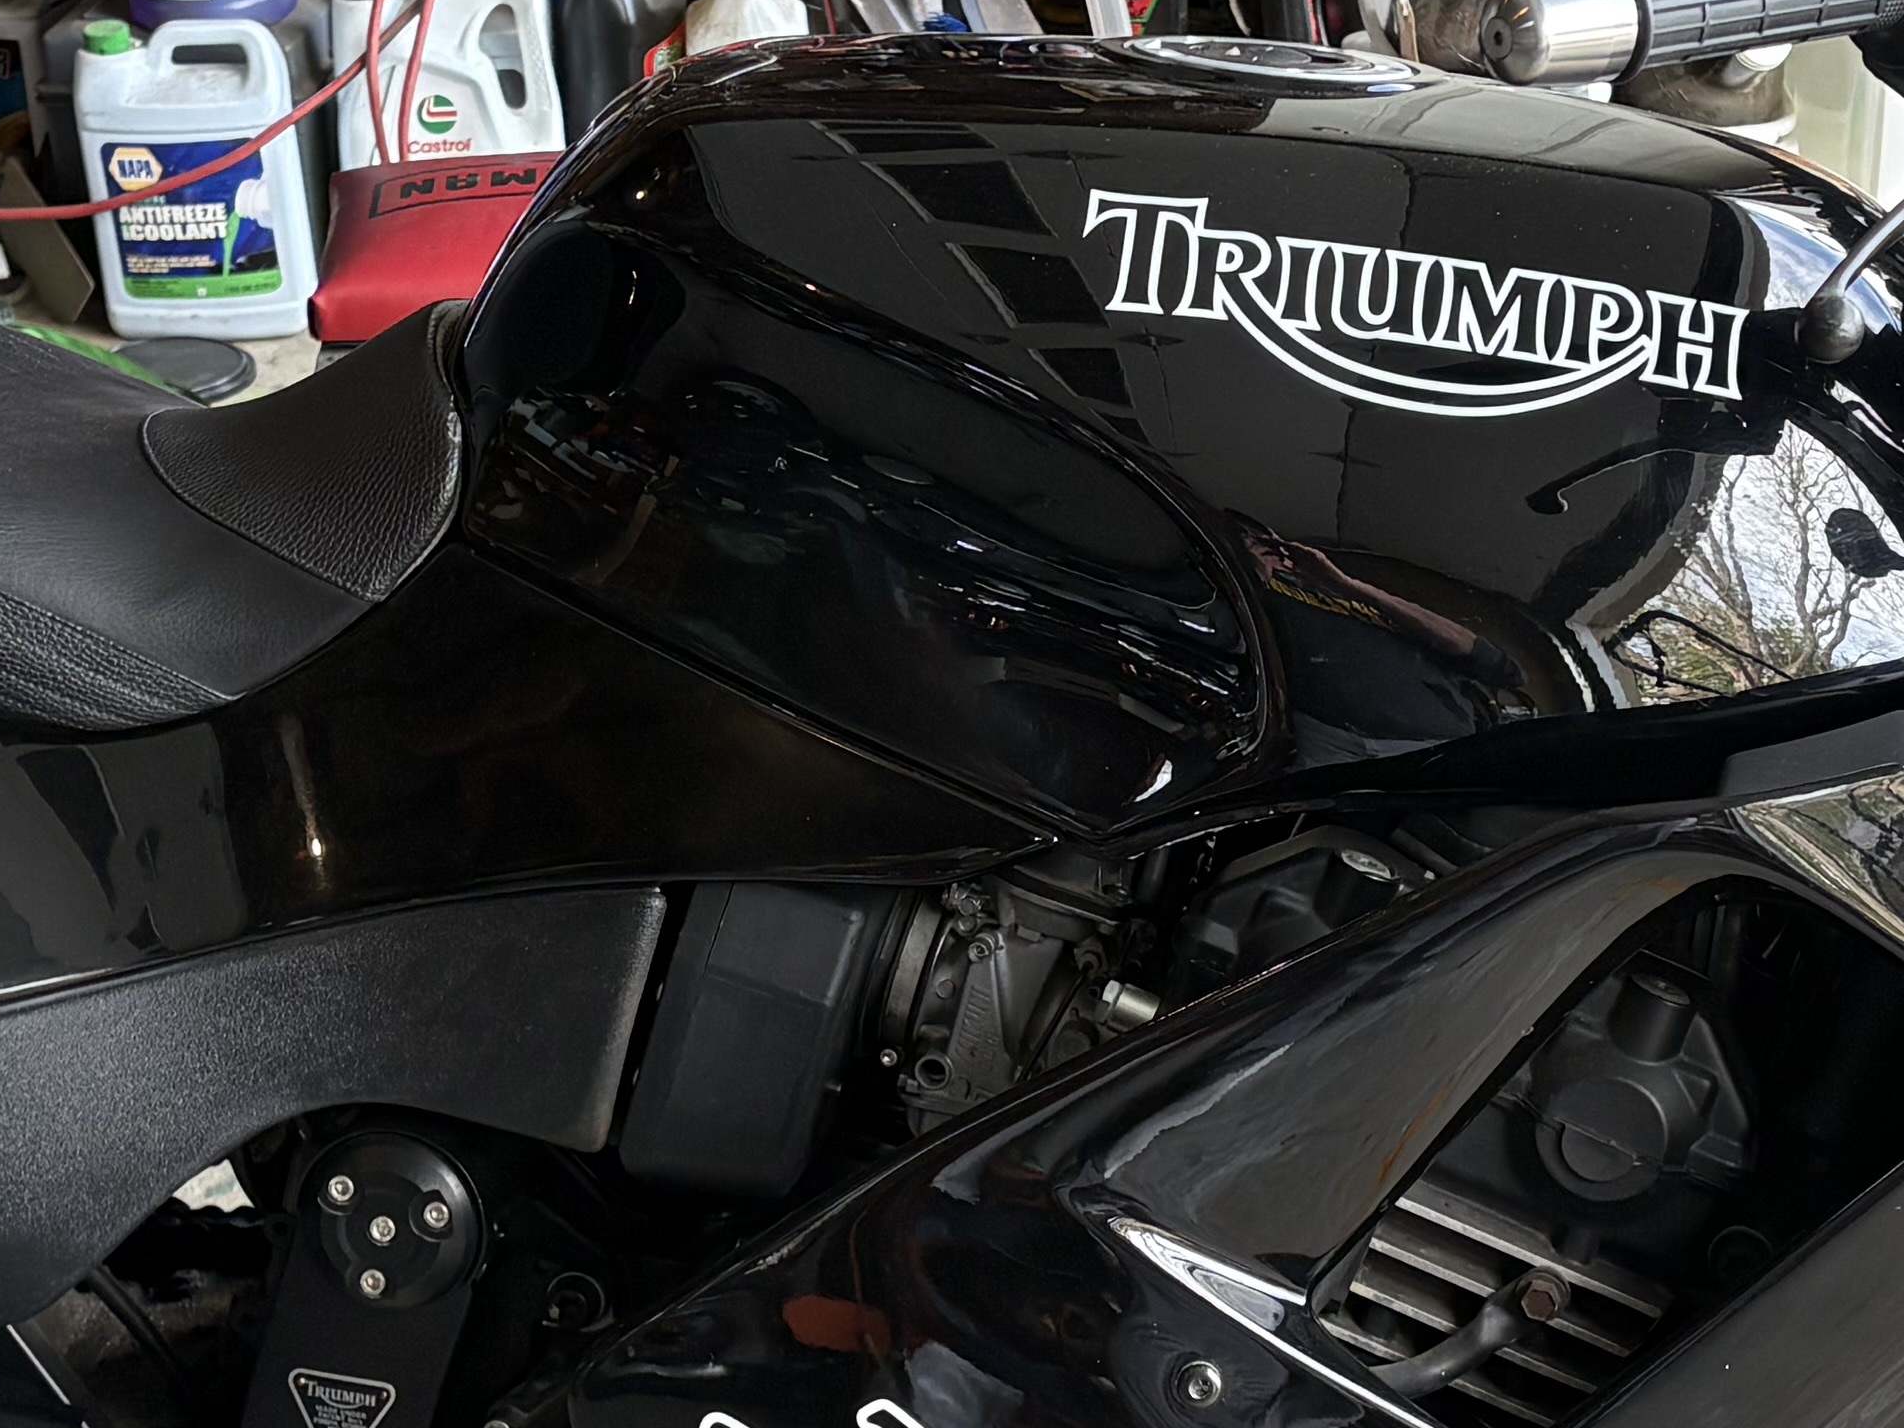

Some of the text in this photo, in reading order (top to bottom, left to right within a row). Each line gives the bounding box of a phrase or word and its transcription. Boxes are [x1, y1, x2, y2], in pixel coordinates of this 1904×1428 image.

[407, 137, 473, 155] Castrol
[116, 159, 155, 179] NAPA
[119, 202, 228, 225] ANTIFREEZE
[130, 222, 228, 242] COOLANT
[1082, 188, 1747, 418] TRIUMPH
[304, 1380, 377, 1409] TRIUMPH
